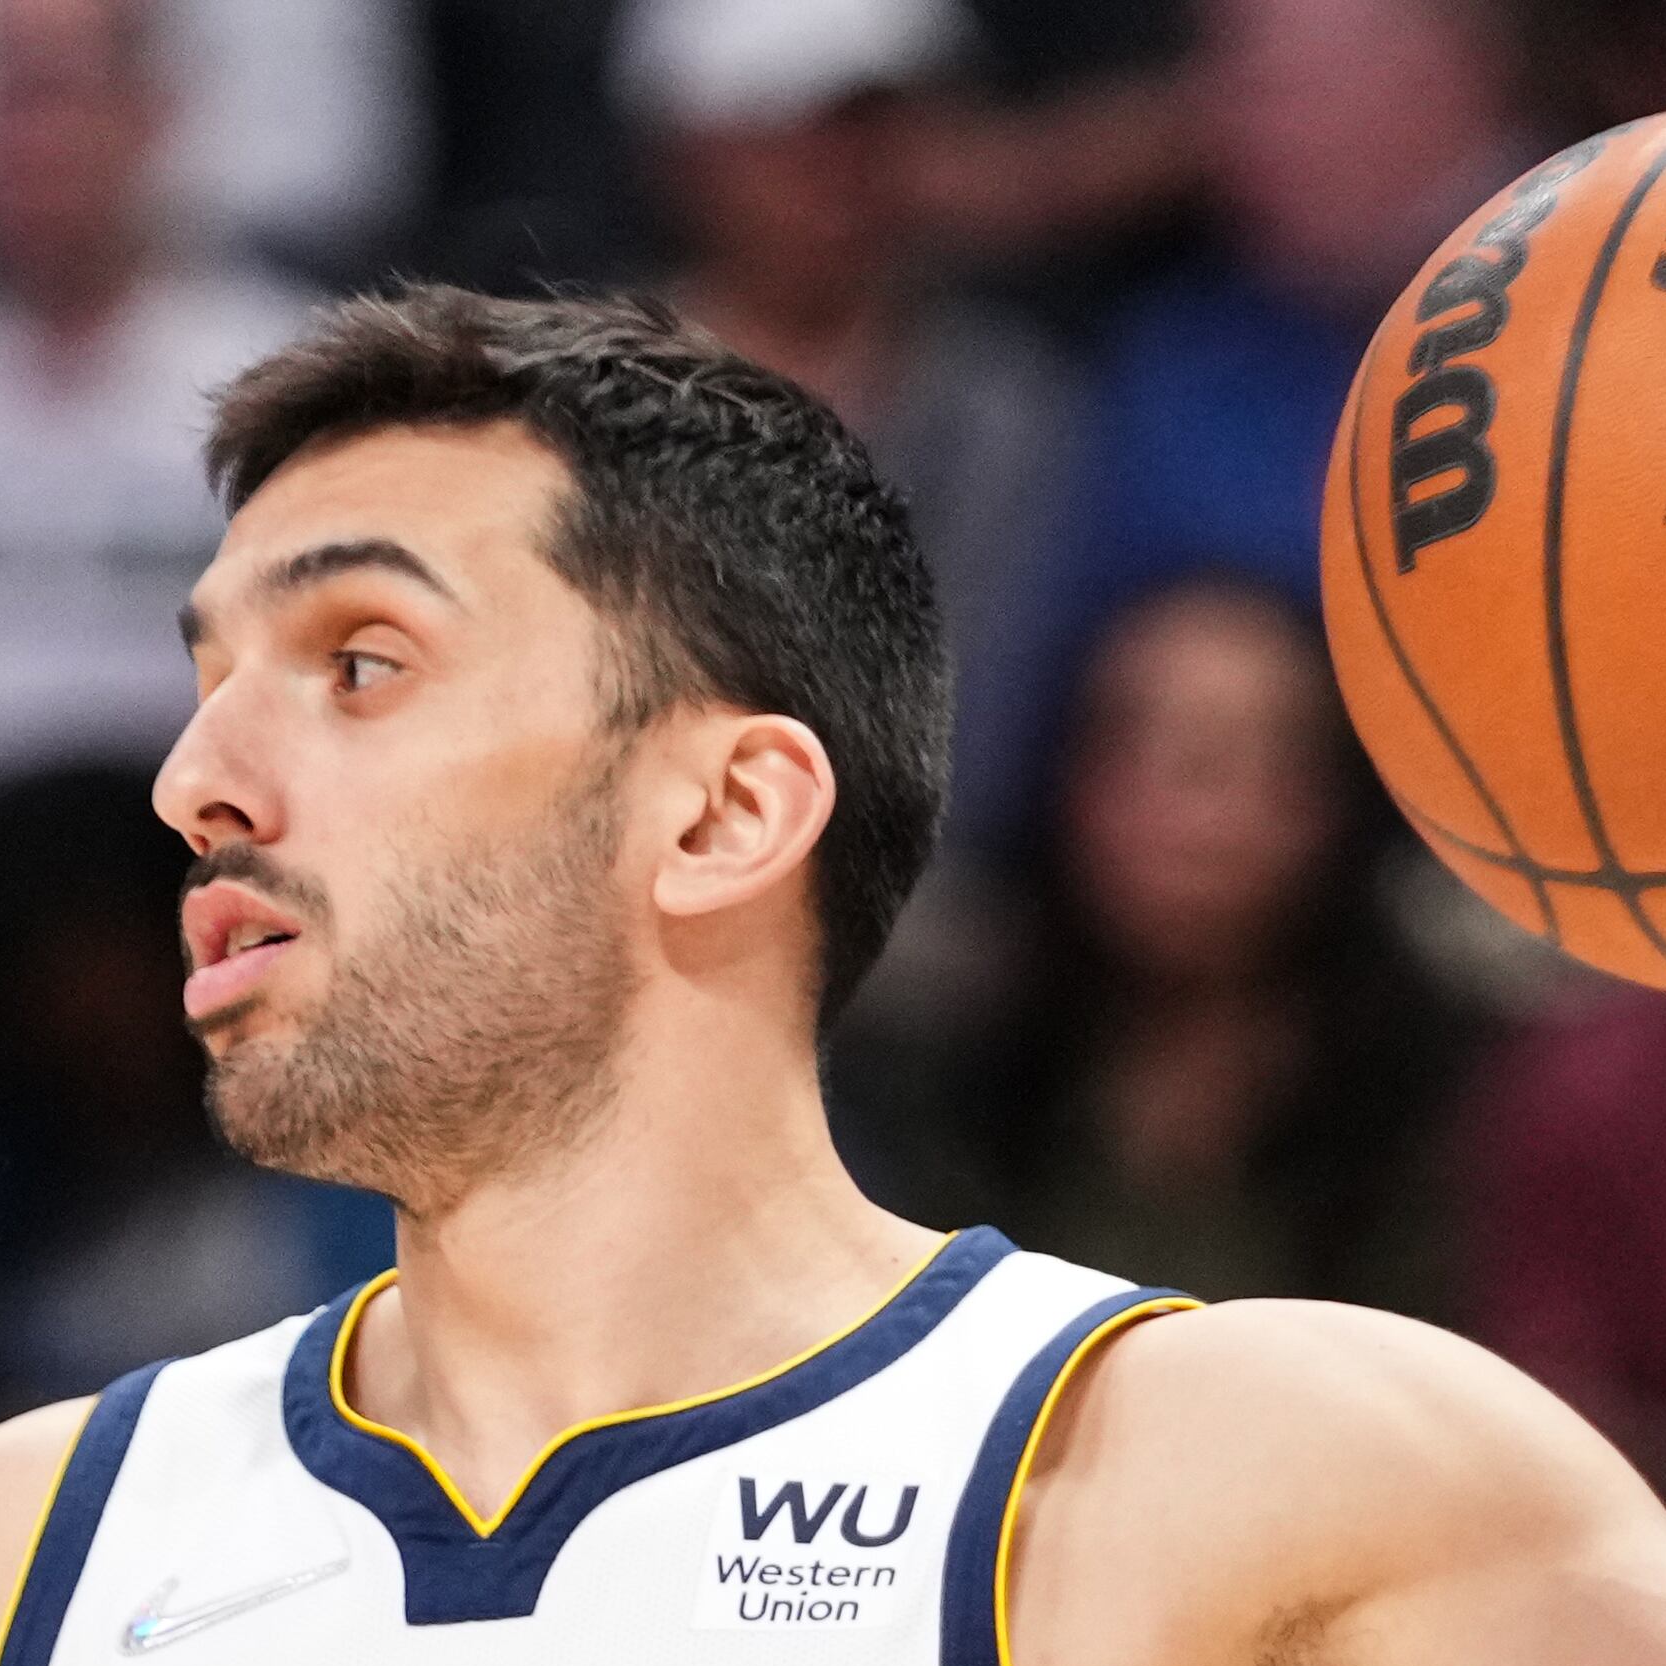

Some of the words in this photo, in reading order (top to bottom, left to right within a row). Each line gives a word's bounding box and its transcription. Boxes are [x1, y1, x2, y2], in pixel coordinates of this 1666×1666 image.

[739, 1476, 920, 1548] WU
[717, 1554, 896, 1587] Western
[738, 1591, 860, 1622] Union
